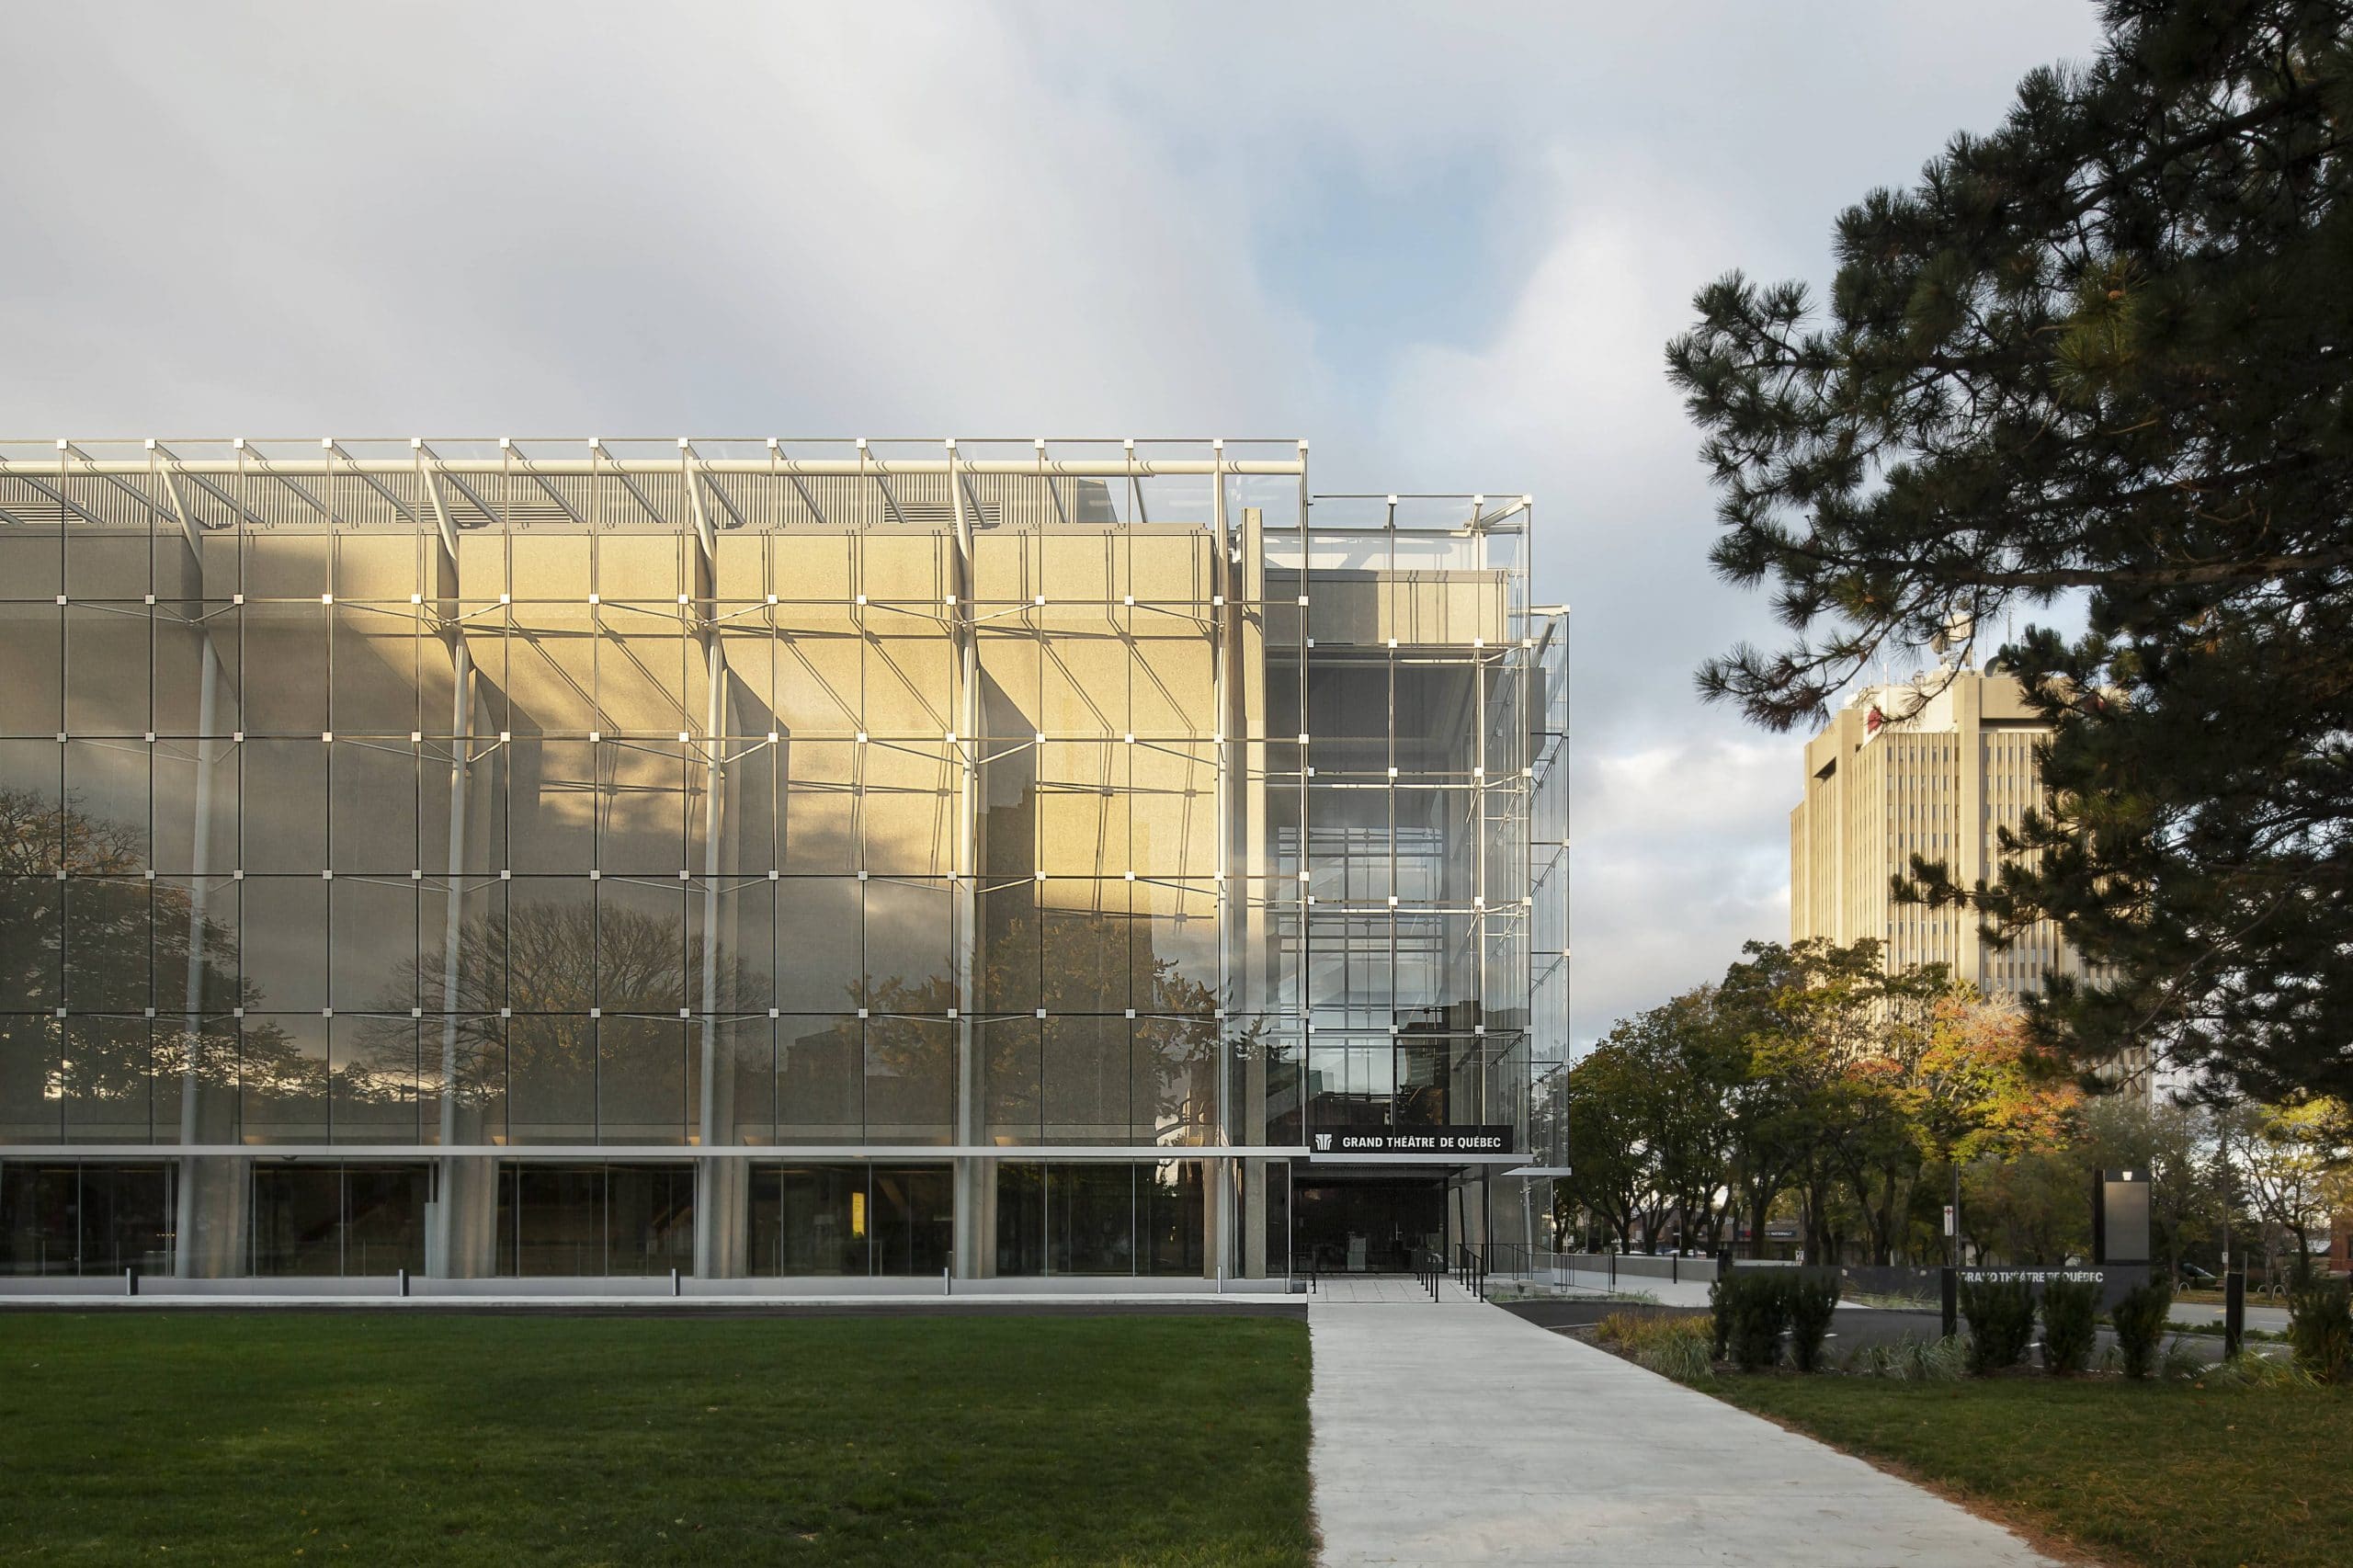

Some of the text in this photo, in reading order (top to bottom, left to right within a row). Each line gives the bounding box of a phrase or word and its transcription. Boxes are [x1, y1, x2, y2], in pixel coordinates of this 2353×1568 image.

[1343, 1135, 1501, 1149] GRAND THÉÂTRE DE QUÉBEC
